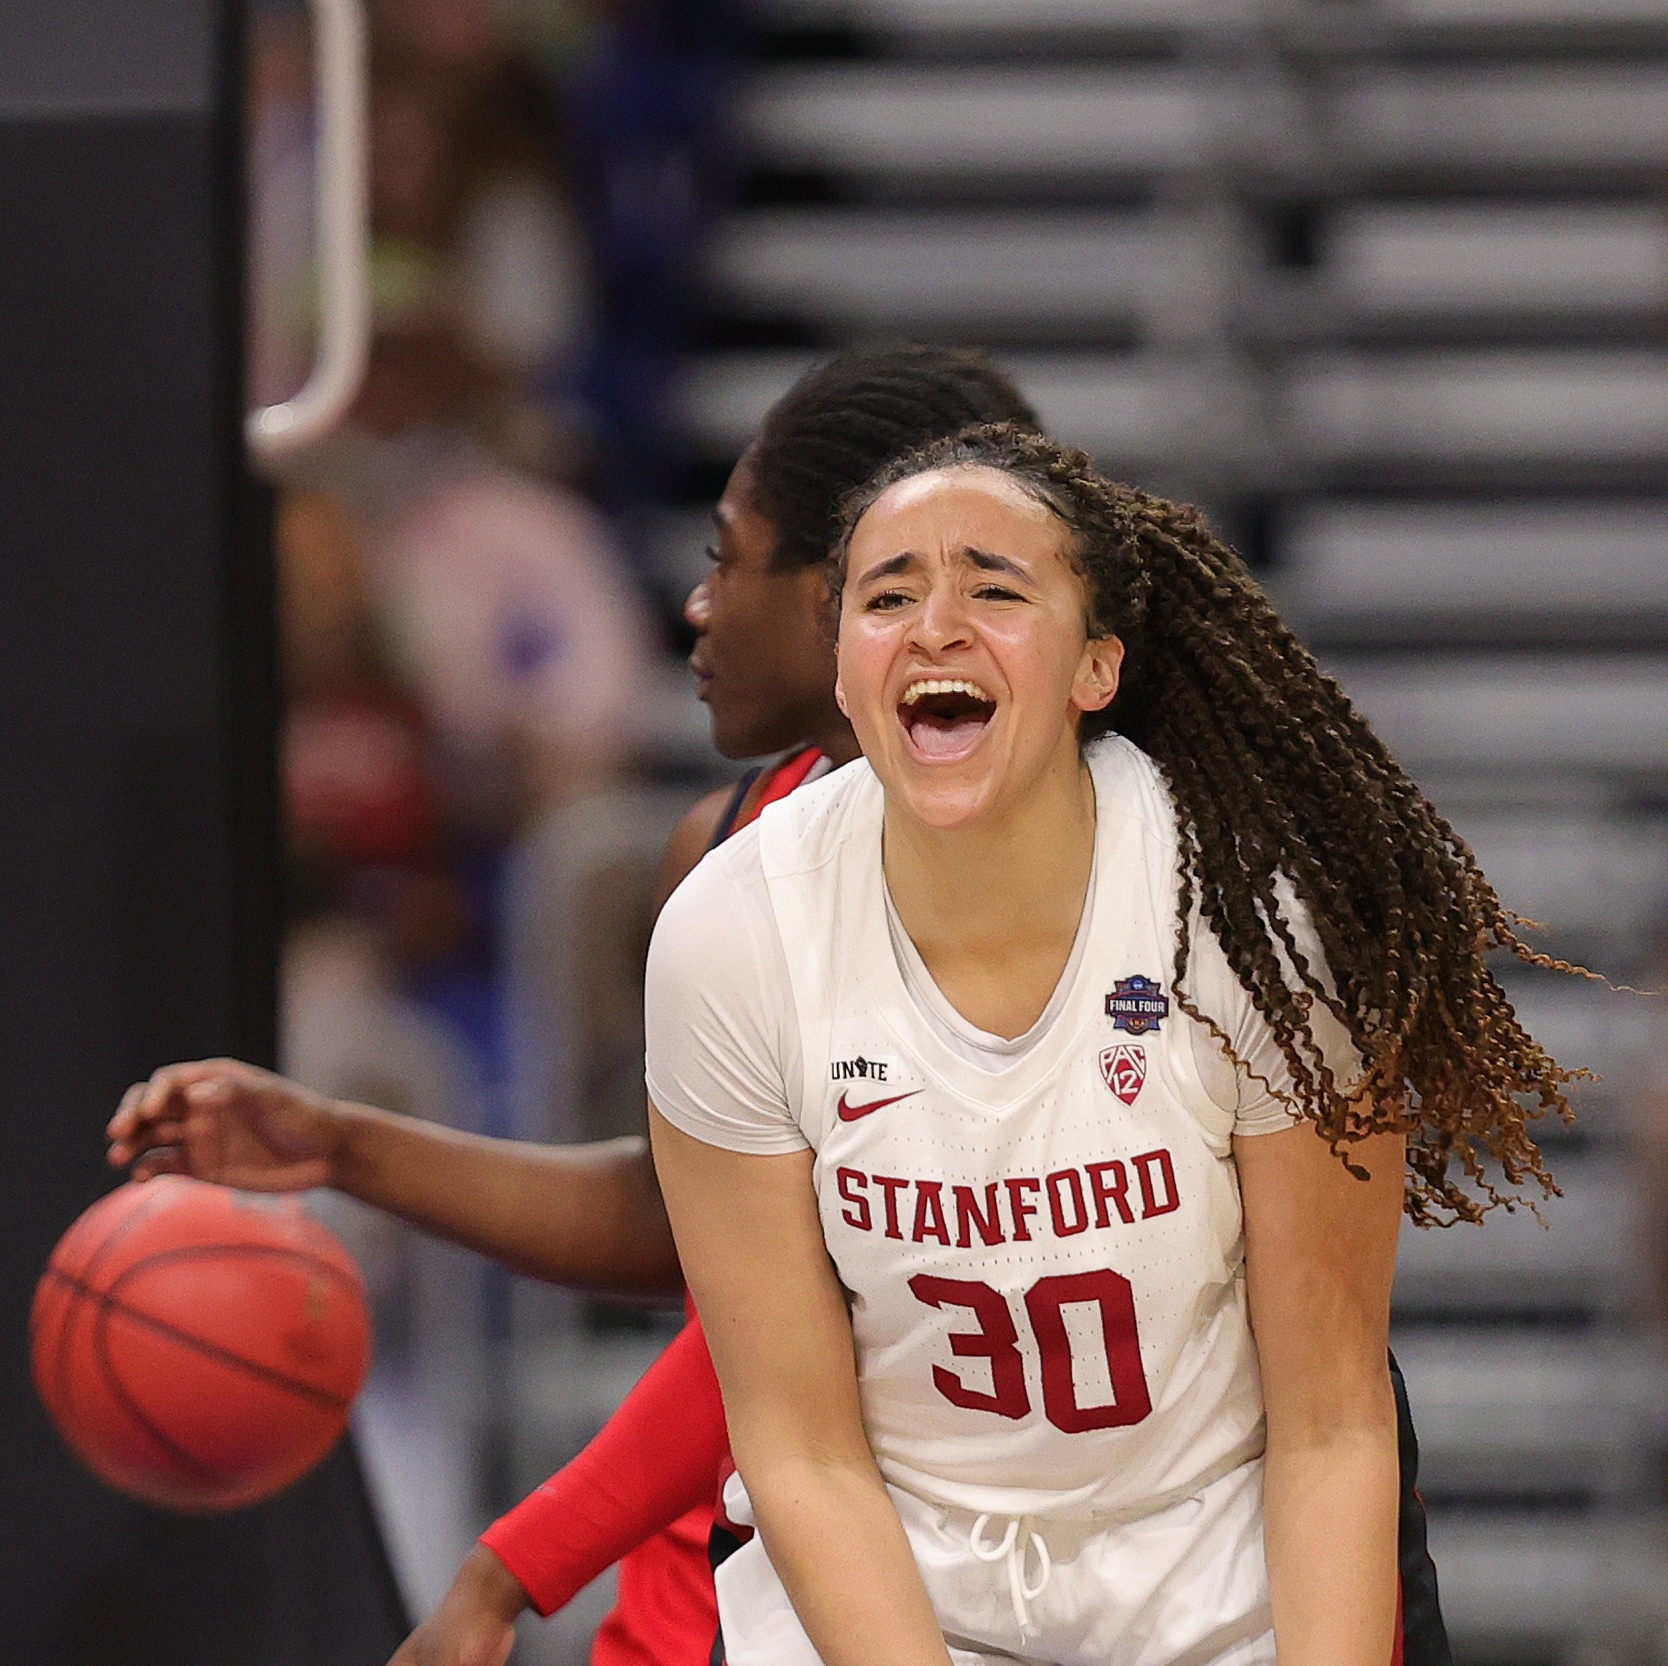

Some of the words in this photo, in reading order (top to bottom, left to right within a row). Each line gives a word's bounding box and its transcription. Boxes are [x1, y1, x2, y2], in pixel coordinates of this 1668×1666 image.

[1110, 1000, 1136, 1012] FINAL
[1138, 1001, 1165, 1013] FOUR
[1099, 1045, 1146, 1083] PAC
[1113, 1070, 1139, 1095] 12
[836, 1148, 1181, 1249] STANFORD
[907, 1268, 1153, 1434] 30
